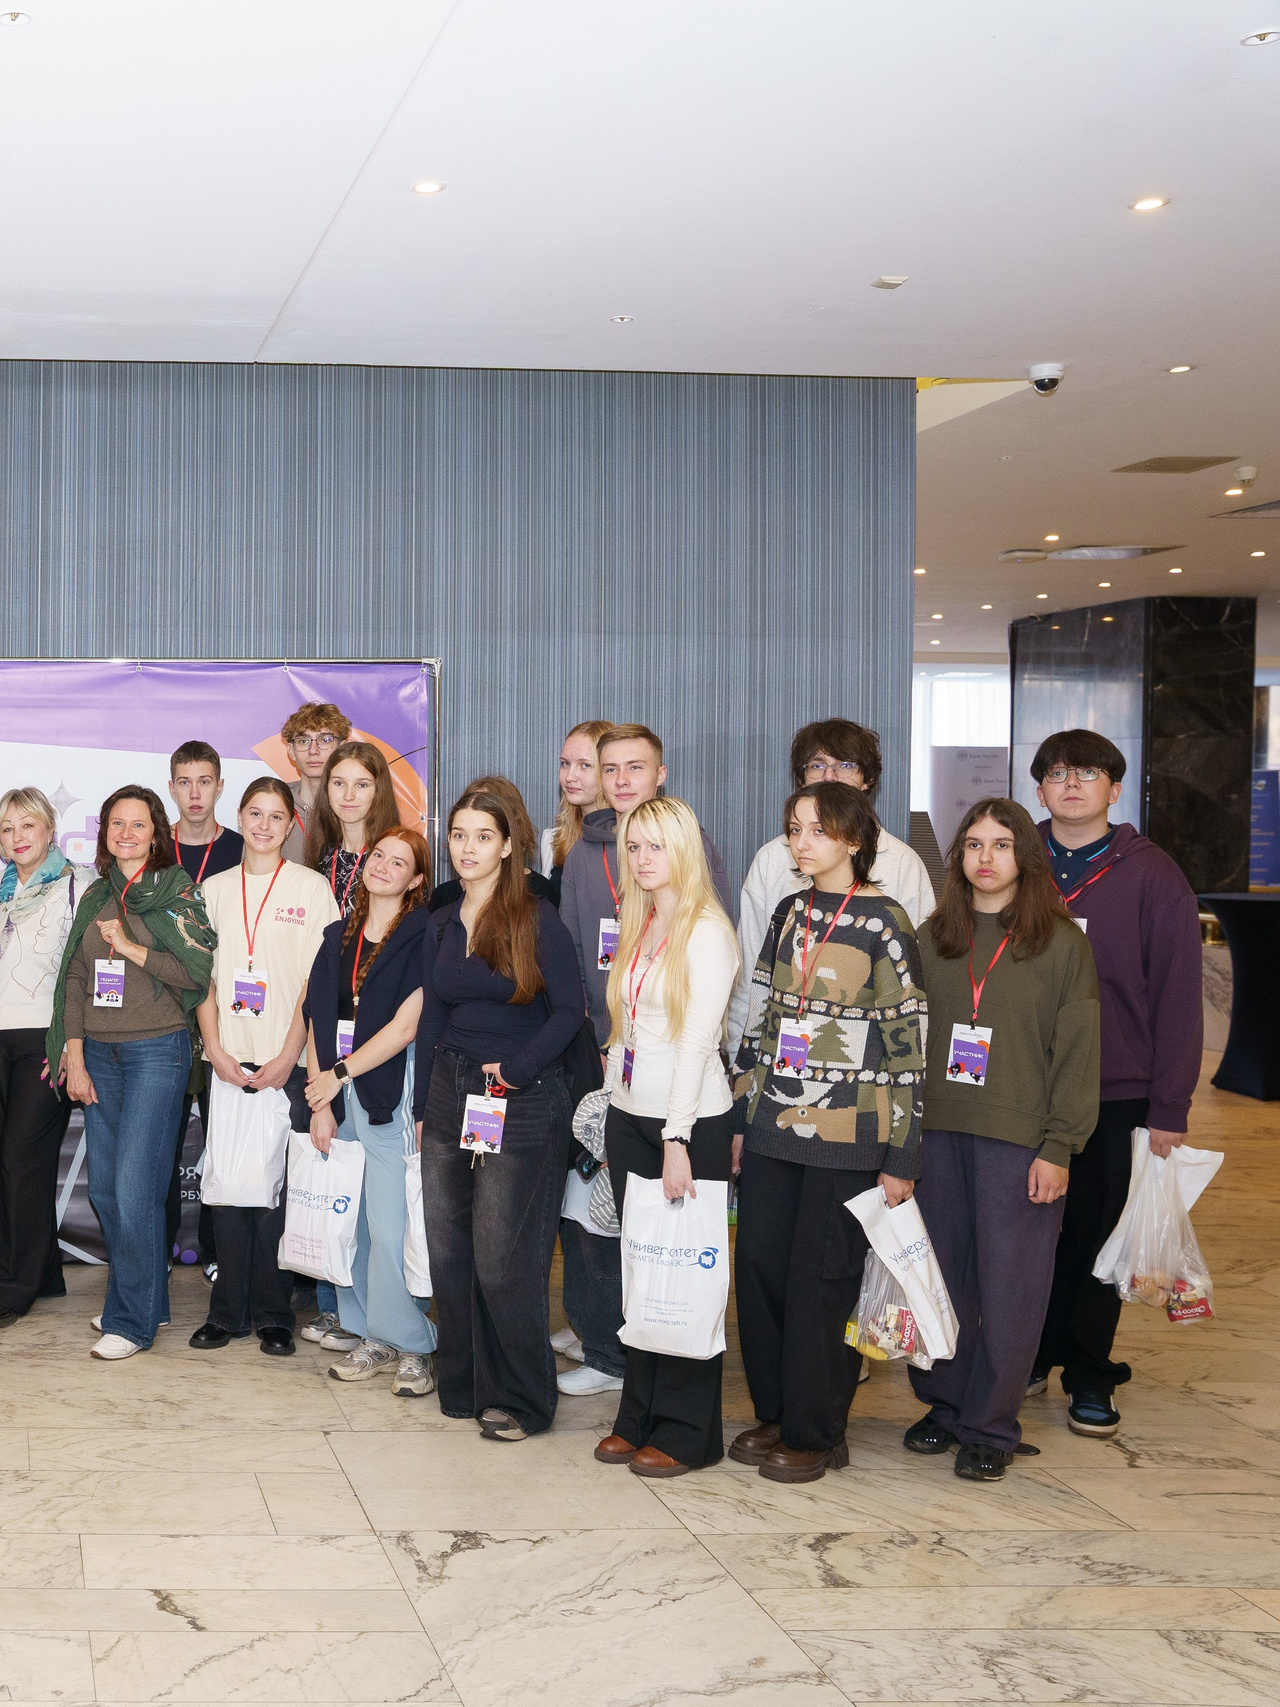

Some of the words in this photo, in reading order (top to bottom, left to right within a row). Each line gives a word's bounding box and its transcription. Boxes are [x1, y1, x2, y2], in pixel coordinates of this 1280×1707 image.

[275, 915, 305, 926] ENJOYING
[953, 1049, 984, 1059] УЧАСТНИК
[468, 1119, 500, 1129] УЧАСТНИК
